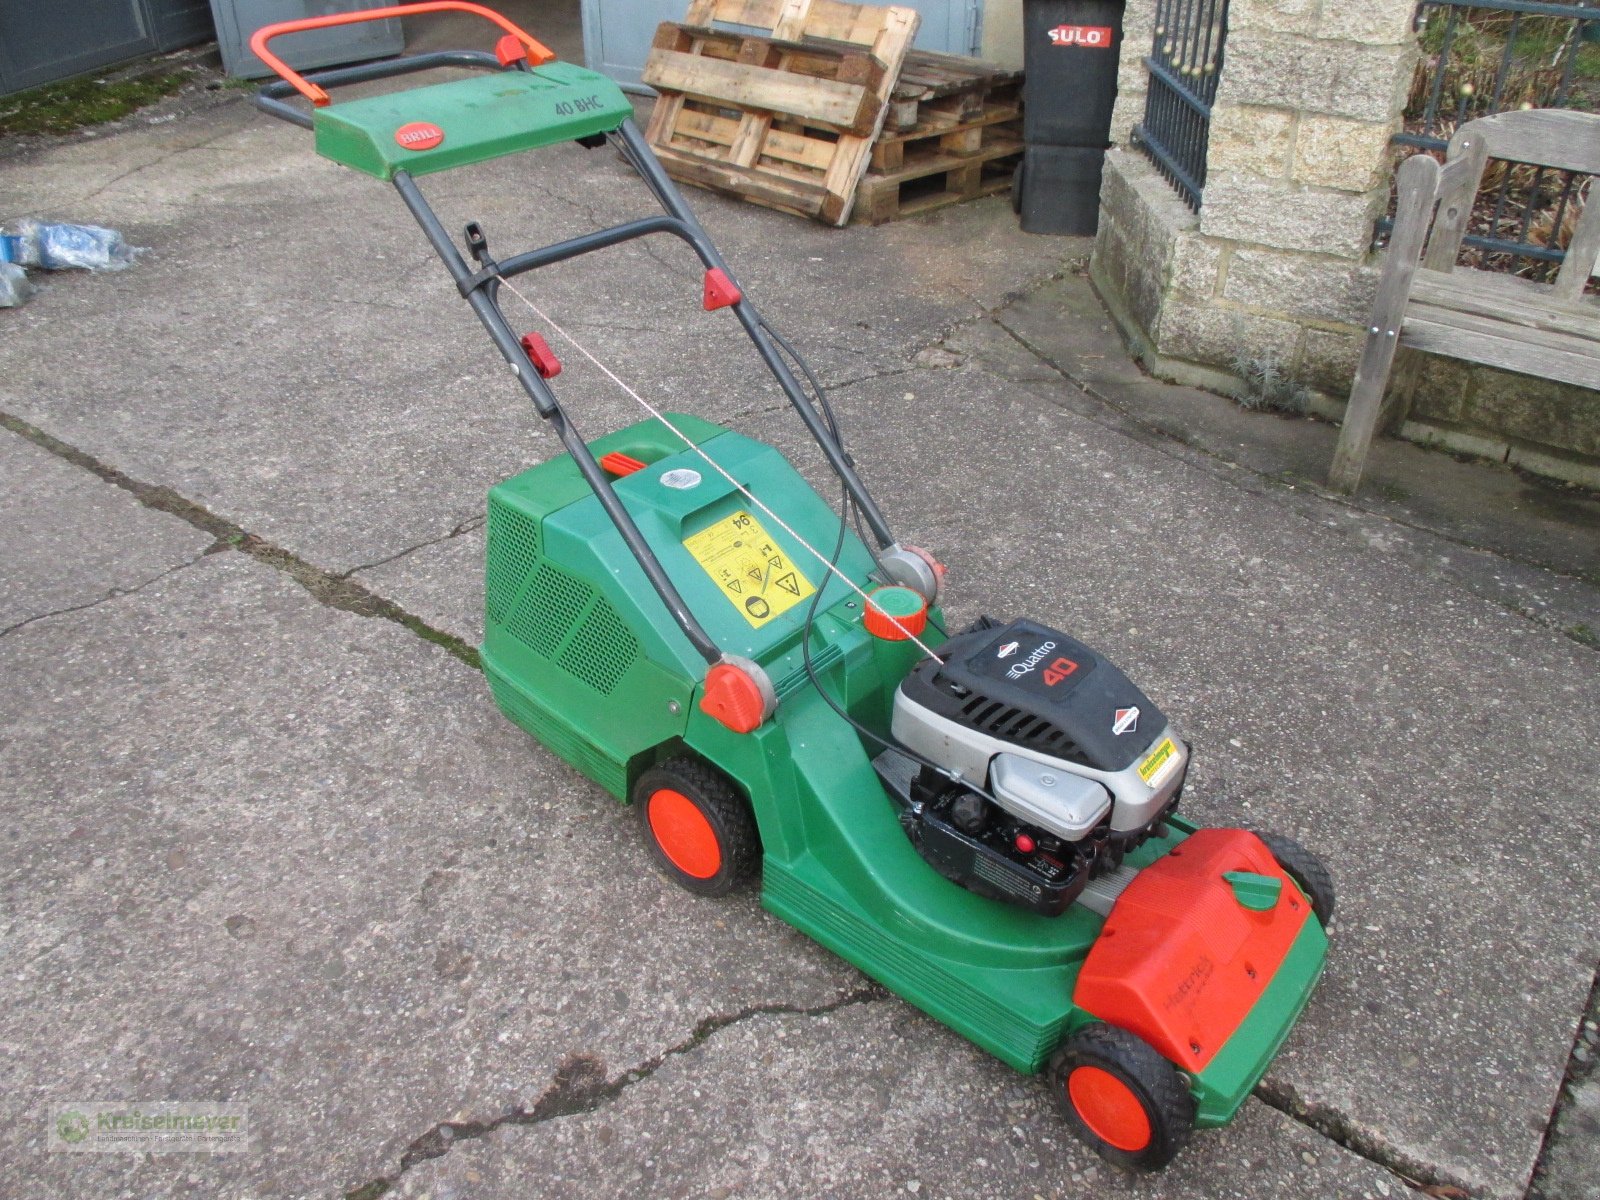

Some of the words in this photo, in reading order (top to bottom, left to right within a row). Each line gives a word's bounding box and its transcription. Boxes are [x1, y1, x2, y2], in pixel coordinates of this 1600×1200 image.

[1047, 29, 1101, 43] SULO
[555, 101, 573, 116] 40
[574, 95, 605, 113] BHC
[400, 127, 442, 144] BRILL
[732, 514, 750, 530] 94
[1011, 641, 1056, 674] Quattro
[1043, 657, 1078, 686] 40
